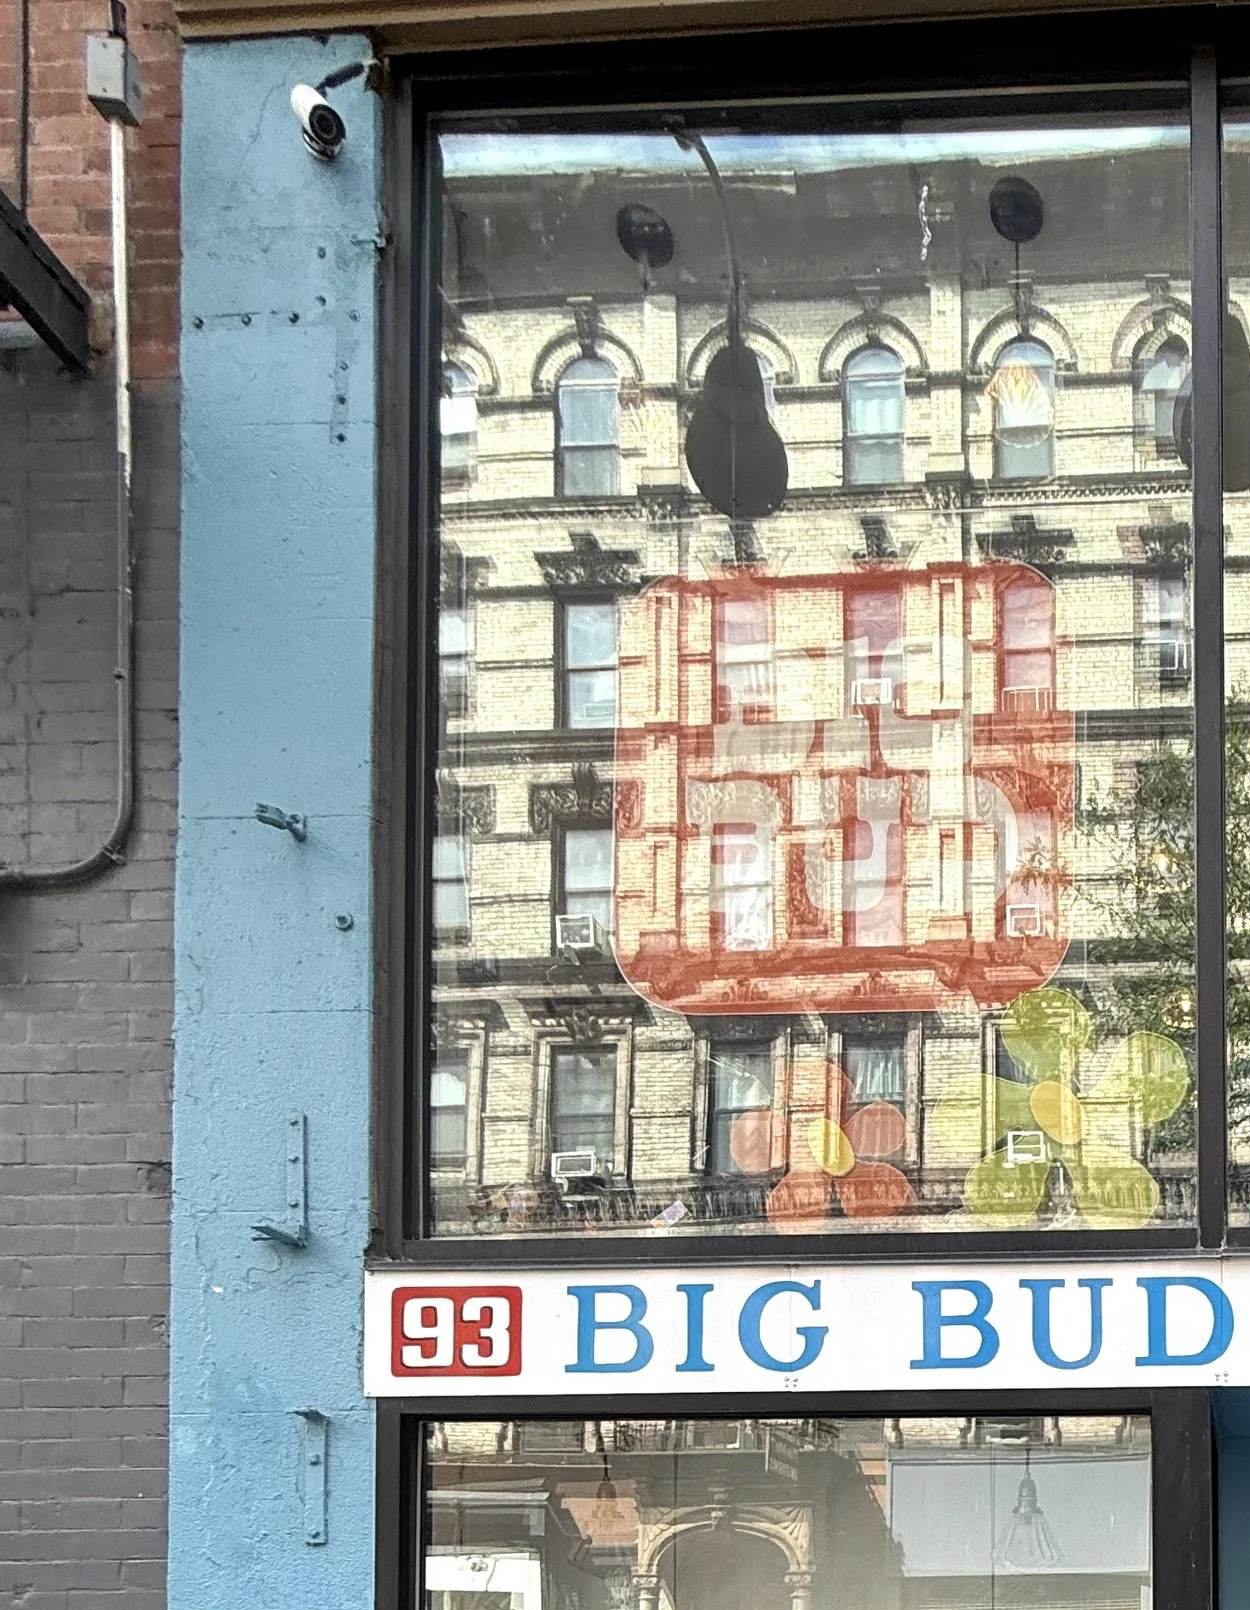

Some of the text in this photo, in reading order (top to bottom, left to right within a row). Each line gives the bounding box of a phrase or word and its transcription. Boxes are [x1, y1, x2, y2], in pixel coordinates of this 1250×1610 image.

[686, 775, 1021, 913] BUD
[400, 1295, 513, 1369] 93
[565, 1279, 830, 1374] BIG
[910, 1276, 1236, 1370] BUD
